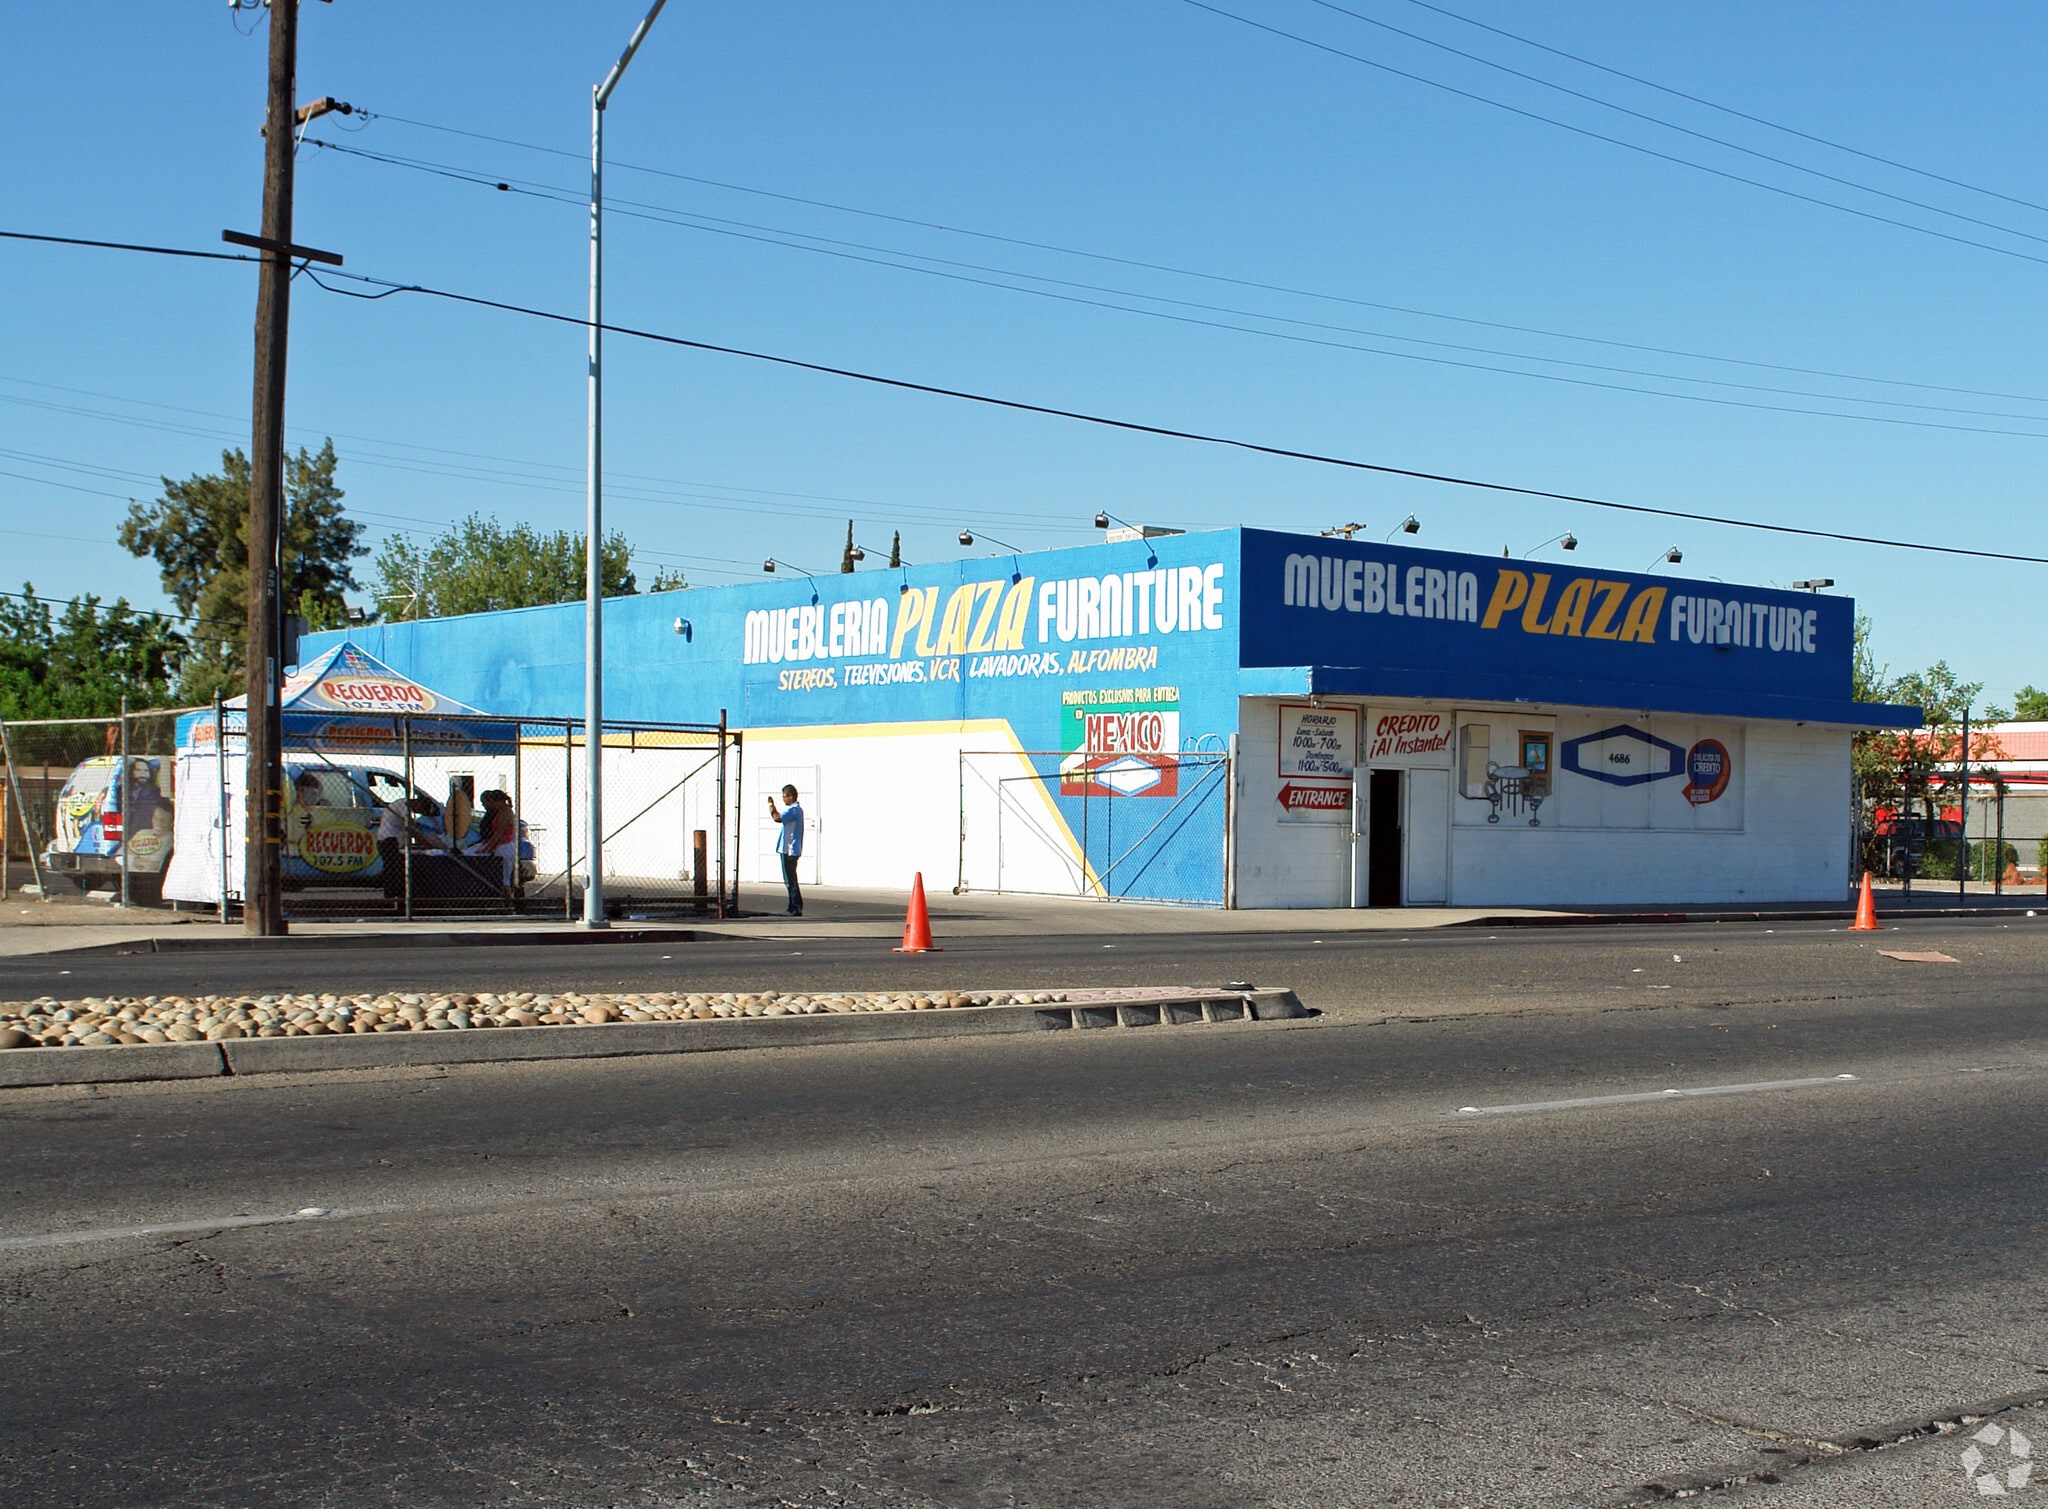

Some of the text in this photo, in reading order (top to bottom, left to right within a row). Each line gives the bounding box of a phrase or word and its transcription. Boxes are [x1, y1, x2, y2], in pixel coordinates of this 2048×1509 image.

[743, 562, 1224, 664] MUEBLERIA PLAZA FURNITURE
[1284, 553, 1817, 654] MUEBLERIA PLAZA FURNITURE
[778, 667, 838, 692] STEREOS,
[929, 657, 960, 683] VCR
[969, 651, 1064, 679] LAVADORAS,
[1067, 646, 1158, 674] ALFOMBRA
[322, 682, 424, 702] RECUERDO
[341, 701, 425, 712] 107.5 FM
[1086, 713, 1163, 753] MEXICO
[1376, 714, 1440, 737] CREDITO
[1394, 730, 1451, 755] Instante!
[1609, 753, 1631, 764] 4686
[1693, 762, 1721, 774] CREDITO
[1288, 790, 1347, 806] ENTRANCE
[307, 831, 374, 855] RECUERDO
[313, 856, 363, 866] 107.5 FM
